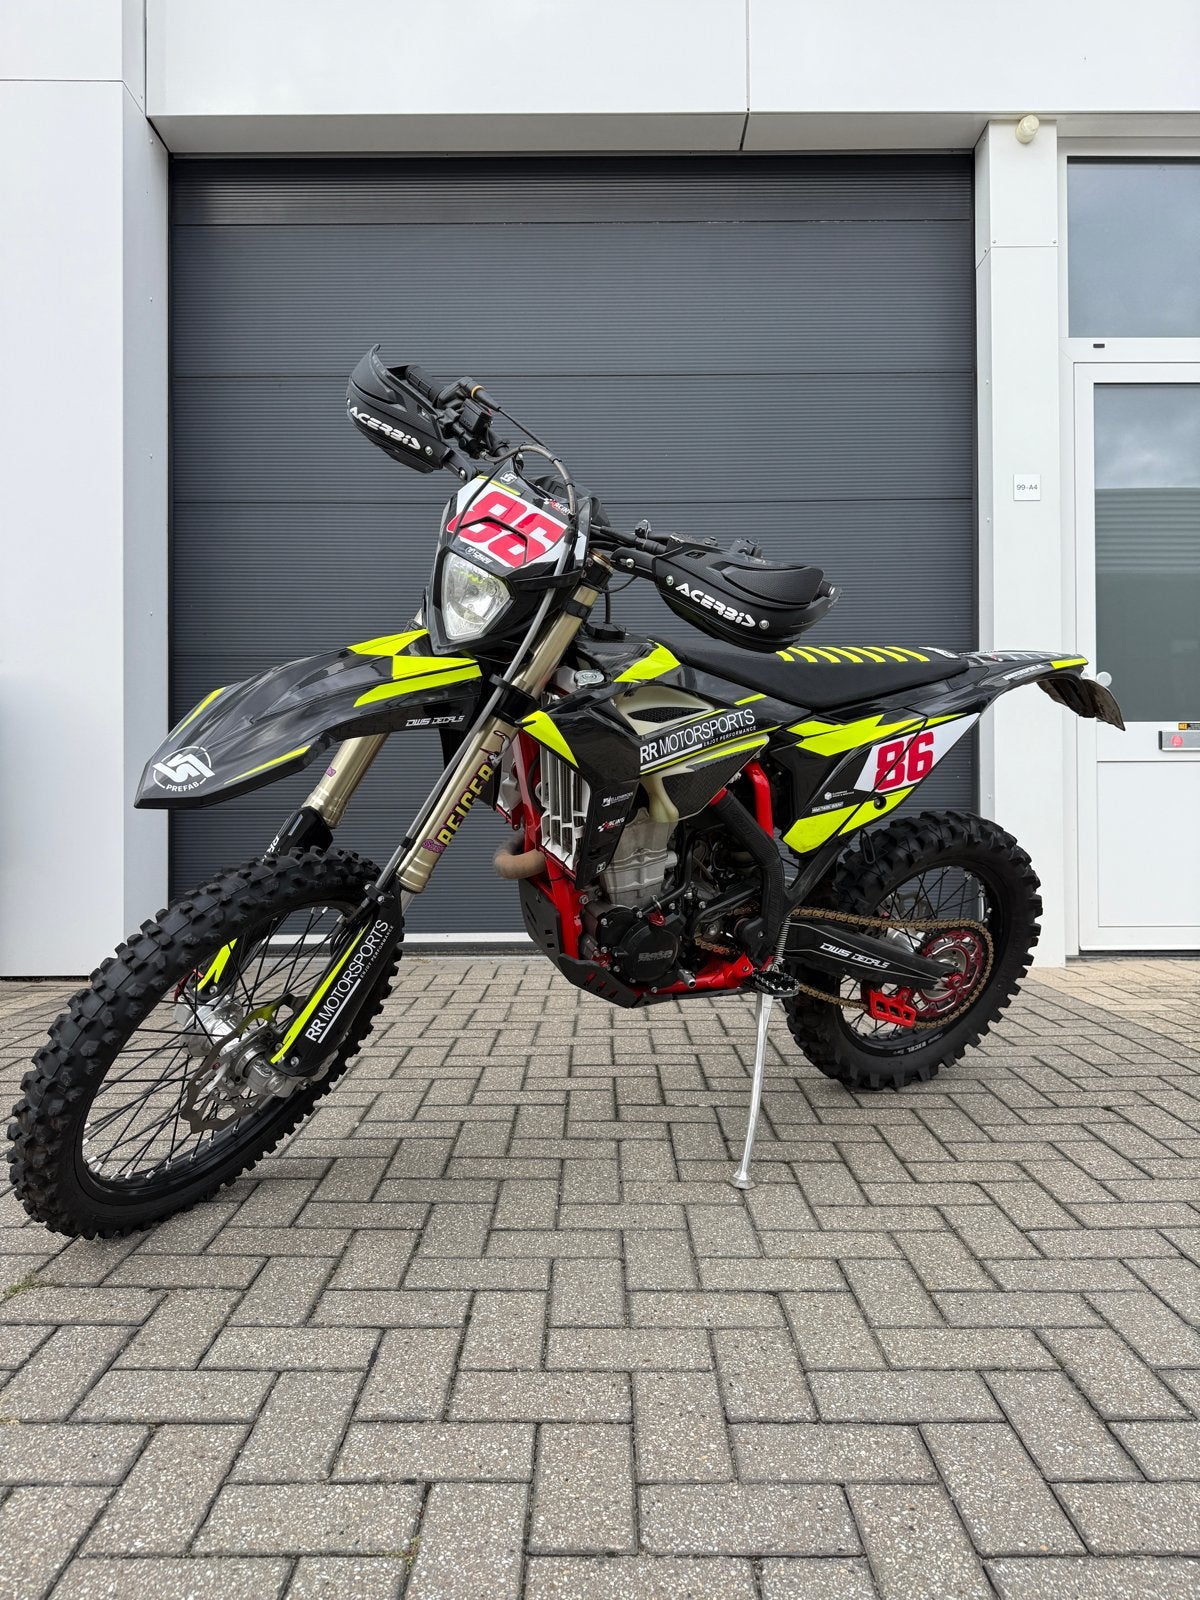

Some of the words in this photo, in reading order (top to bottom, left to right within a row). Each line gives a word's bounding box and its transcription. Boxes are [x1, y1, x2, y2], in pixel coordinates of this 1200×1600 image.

[446, 490, 566, 569] 86
[640, 742, 659, 764] RR
[659, 708, 755, 755] MOTORSPORTS
[703, 737, 719, 747] ENJOY
[720, 725, 757, 741] PERFORMANCE
[873, 731, 935, 792] 86
[166, 781, 200, 792] PREFAB
[371, 925, 394, 962] PERFORMANCE
[305, 1018, 327, 1042] RR
[318, 919, 389, 1021] MOTORSPORTS
